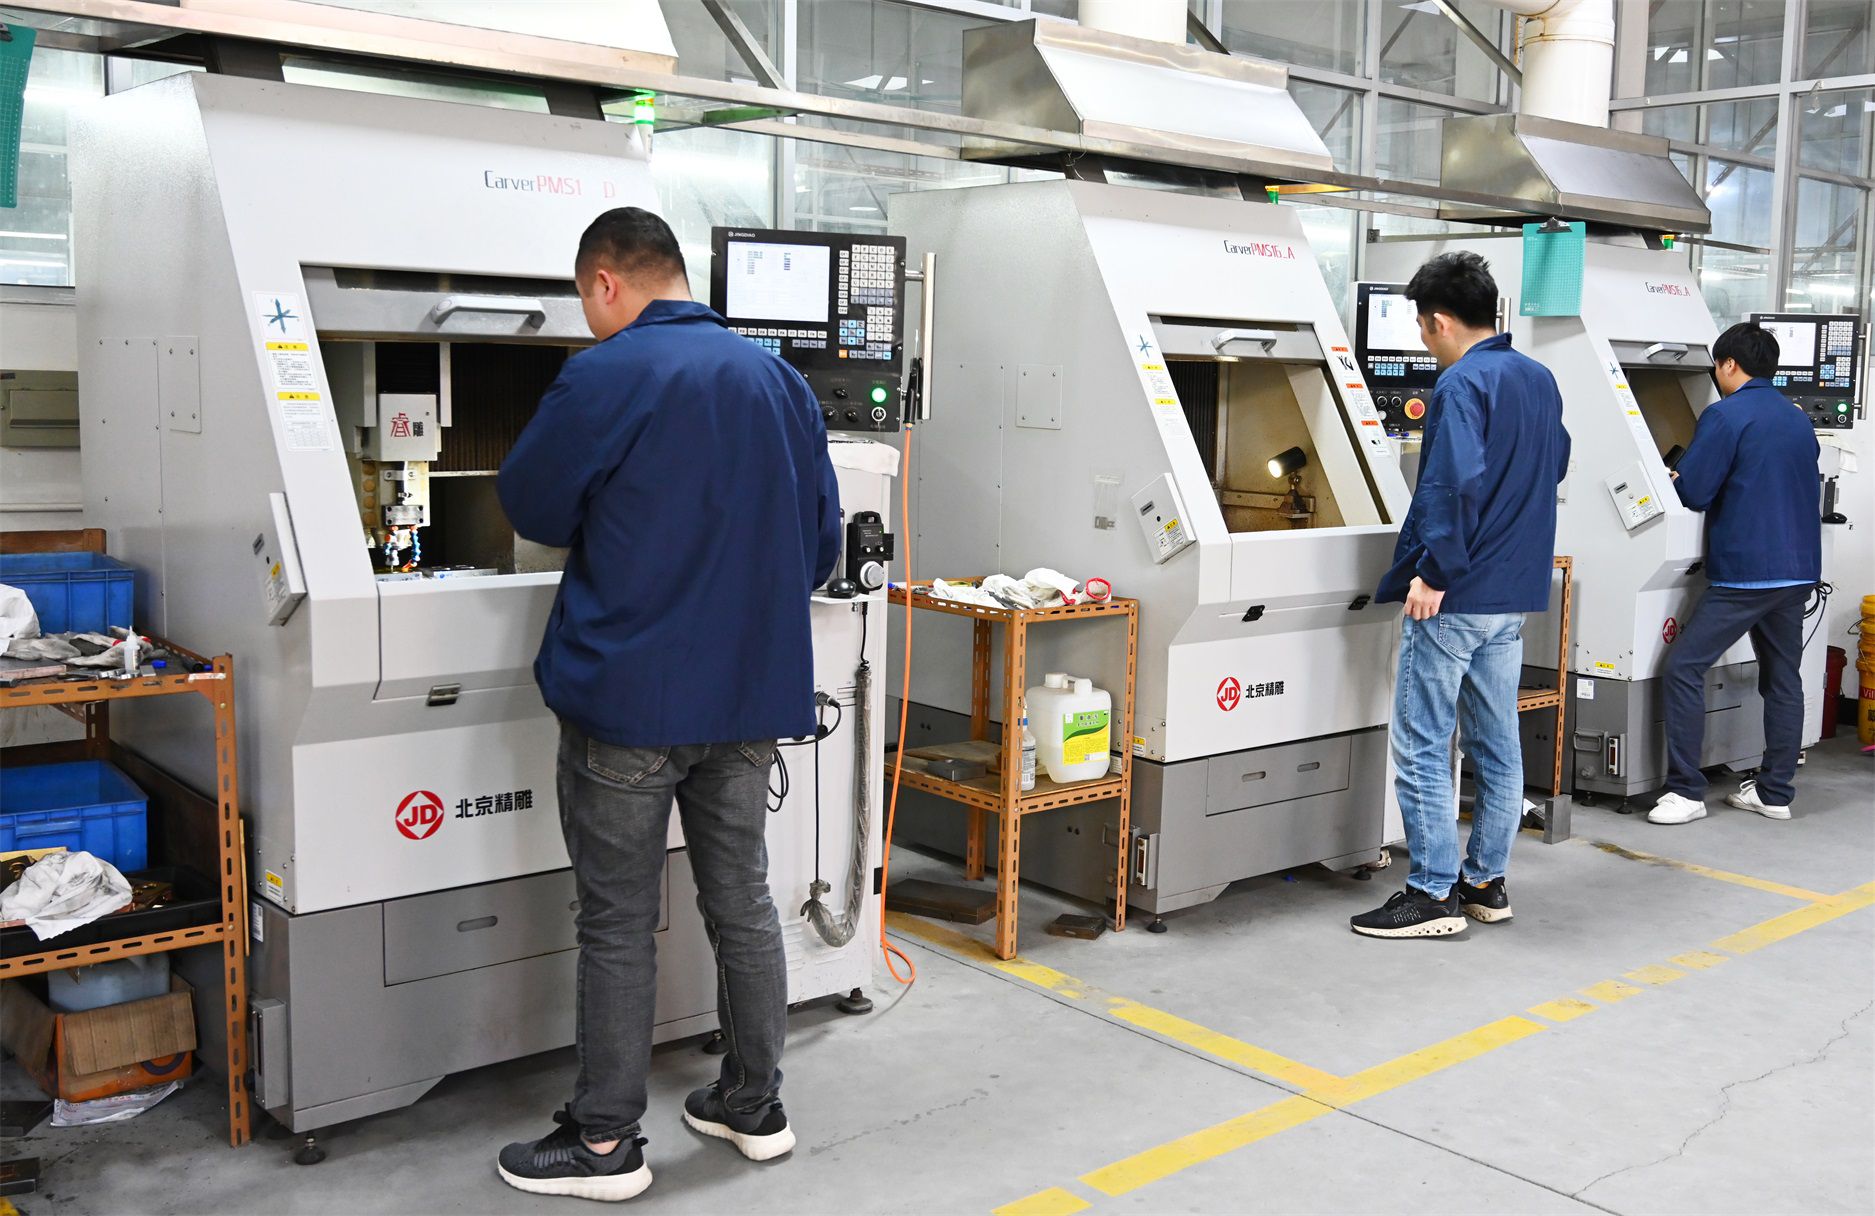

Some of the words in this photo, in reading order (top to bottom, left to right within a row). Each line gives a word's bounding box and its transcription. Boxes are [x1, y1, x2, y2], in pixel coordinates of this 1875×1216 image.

[1220, 686, 1238, 702] JD
[1245, 681, 1285, 699] 北京精雕
[455, 789, 533, 819] 北京精雕
[403, 804, 438, 827] JD
